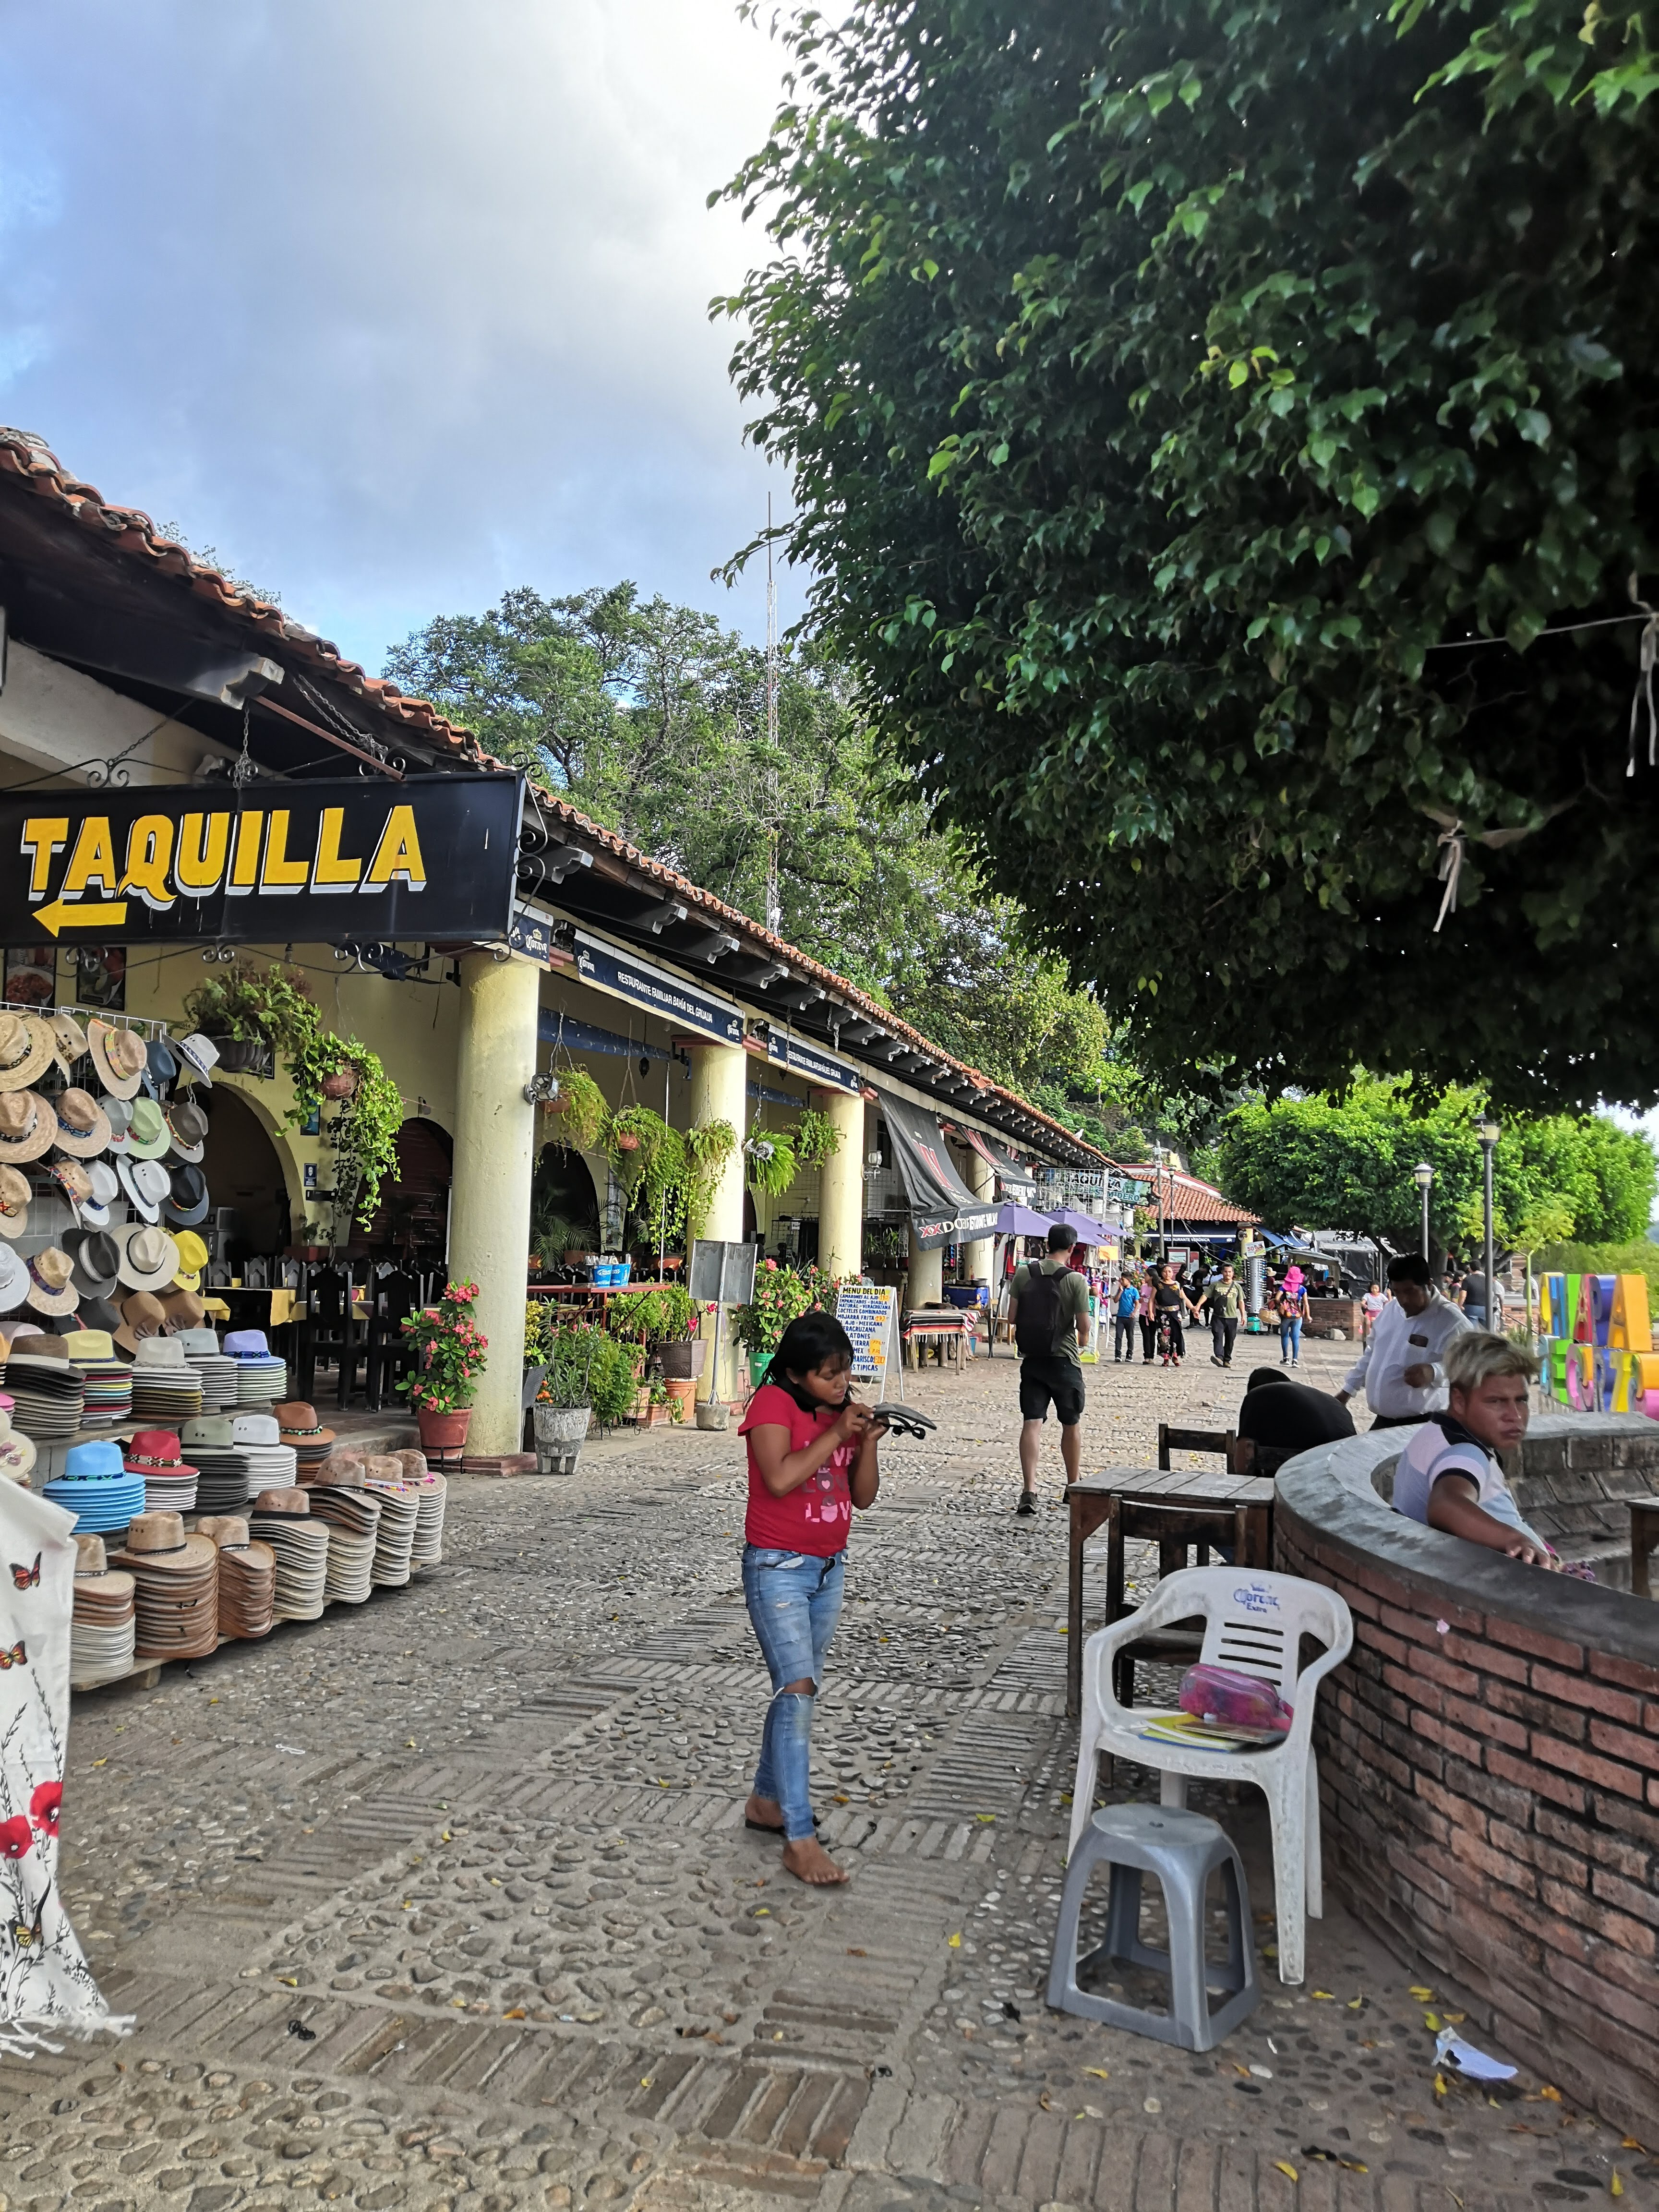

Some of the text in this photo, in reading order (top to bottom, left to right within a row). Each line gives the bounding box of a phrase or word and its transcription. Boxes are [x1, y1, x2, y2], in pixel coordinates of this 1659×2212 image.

[21, 805, 427, 911] TAQUILLA
[617, 971, 652, 996] RESTAURANTE
[651, 987, 673, 1005] FAMILIAR
[673, 996, 686, 1011] BAHÍA
[686, 1003, 695, 1015] DEL
[1067, 1172, 1121, 1189] TAQUILA
[1094, 1188, 1140, 1201] SMIDERO
